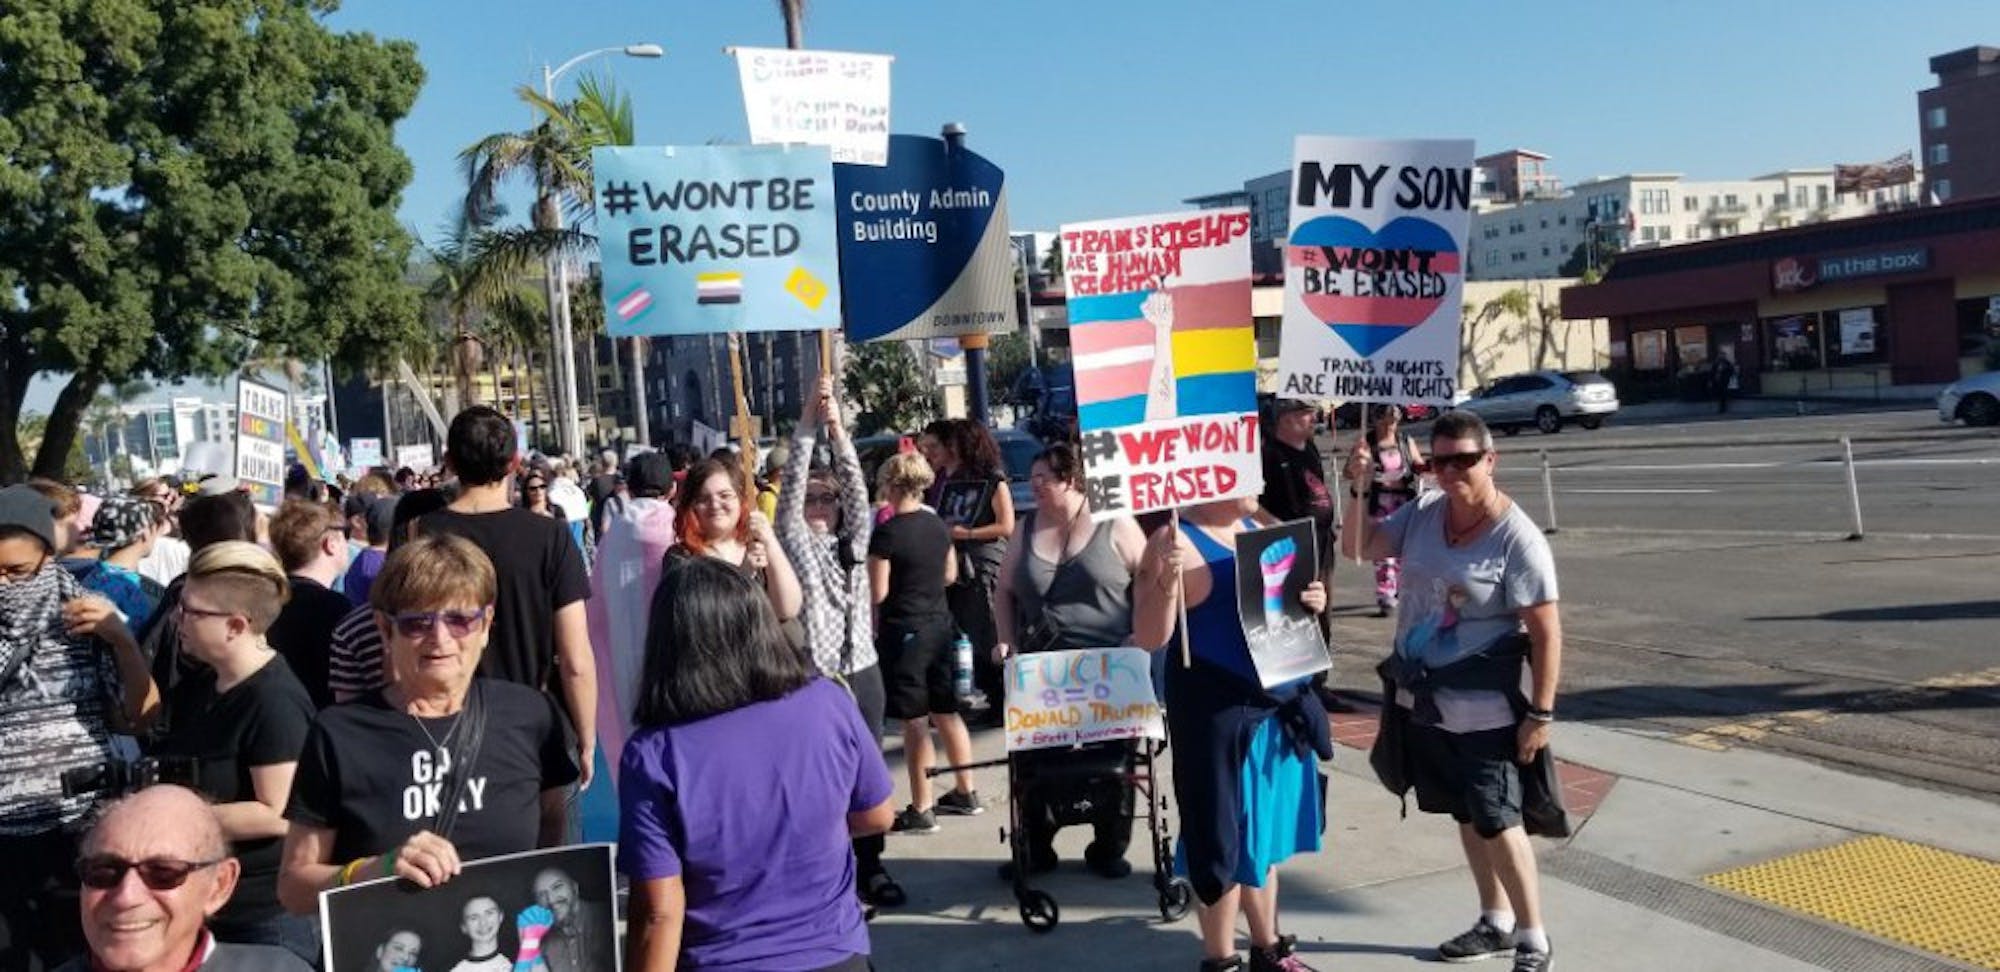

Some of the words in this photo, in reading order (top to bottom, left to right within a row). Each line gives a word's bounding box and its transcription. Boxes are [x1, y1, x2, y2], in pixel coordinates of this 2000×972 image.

[851, 188, 921, 215] County
[929, 186, 990, 209] Admin
[1297, 162, 1390, 208] MY
[1394, 165, 1472, 210] SON
[629, 223, 801, 266] ERASED
[854, 217, 938, 243] Building
[1066, 254, 1098, 272] ARE
[1106, 247, 1182, 277] HUMAN
[1823, 260, 1841, 277] in
[1845, 257, 1878, 273] the
[1882, 253, 1920, 269] box
[1304, 268, 1341, 295] BE
[1354, 269, 1447, 299] ERASED
[933, 311, 1007, 328] DOWNTOWN
[1320, 358, 1375, 375] TRANS
[1385, 360, 1445, 376] RIGHTS
[1284, 373, 1326, 396] ARE
[1334, 375, 1393, 397] HUMAN
[1401, 377, 1454, 400] RIGHTS
[1086, 474, 1126, 513] BE
[1129, 465, 1238, 511] ERASED
[1012, 653, 1140, 690] FUCK
[403, 776, 487, 819] OKY
